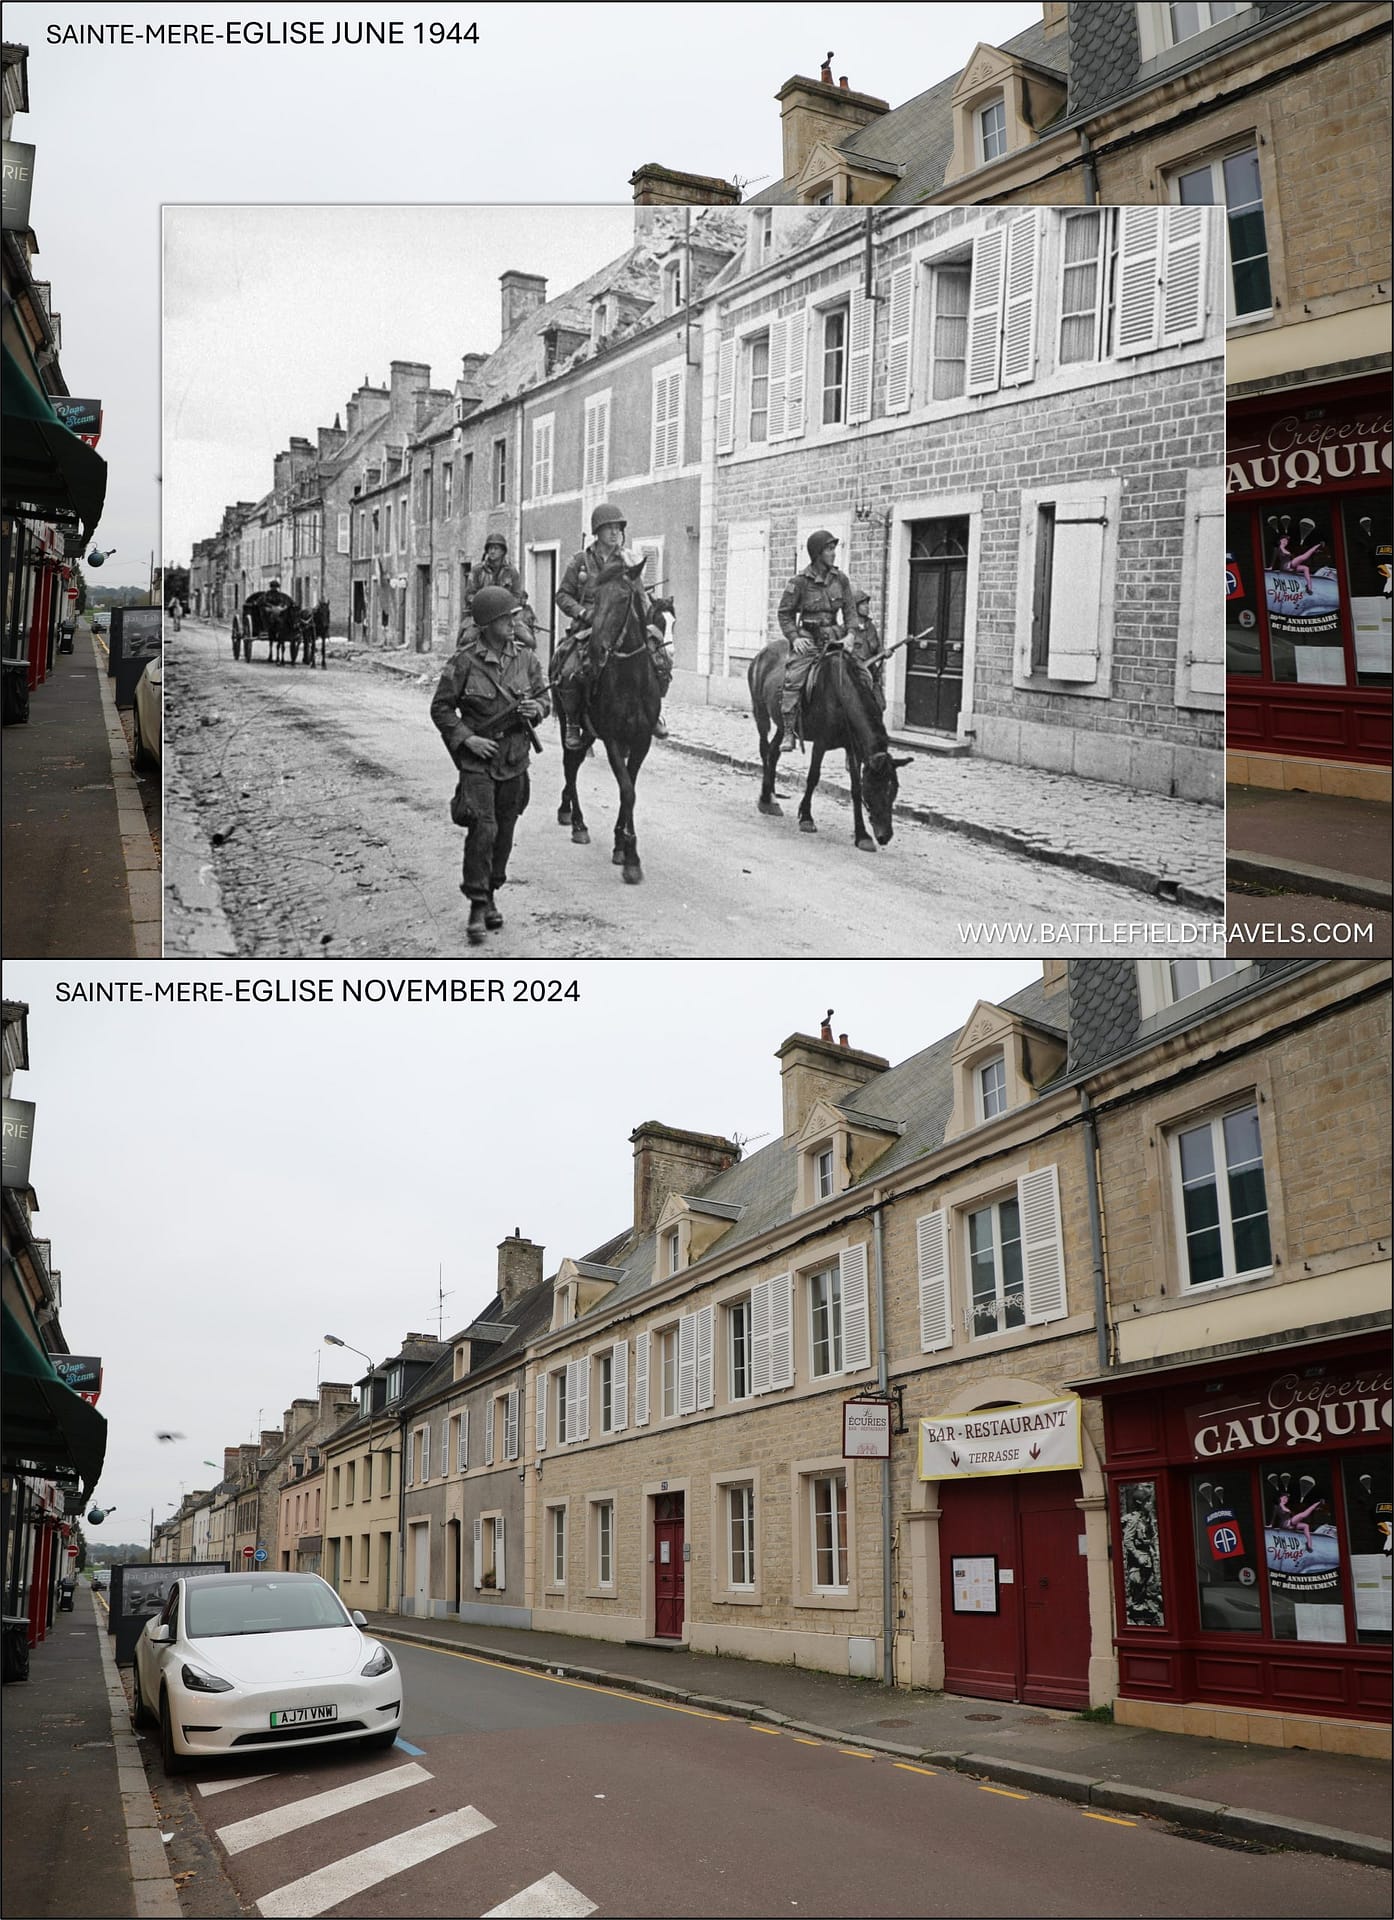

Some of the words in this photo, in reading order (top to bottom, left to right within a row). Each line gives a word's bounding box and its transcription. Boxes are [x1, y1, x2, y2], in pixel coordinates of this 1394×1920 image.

[1267, 415, 1392, 454] Crêperie
[1272, 577, 1300, 592] PIN-UP
[1267, 588, 1304, 604] Wings
[1271, 622, 1281, 630] DU
[1287, 613, 1338, 625] ANNIVERSAIRE
[1267, 1374, 1392, 1412] Crêperie
[848, 1416, 887, 1427] ÉCURIES
[928, 1426, 955, 1443] BAR
[965, 1410, 1067, 1439] RESTAURANT
[969, 1448, 1020, 1464] TERRASSE
[1272, 1535, 1300, 1550] PIN-UP
[1267, 1546, 1304, 1561] Wings
[1271, 1580, 1281, 1588] DU
[1287, 1571, 1338, 1582] ANNIVERSAIRE
[311, 1707, 332, 1719] VNW
